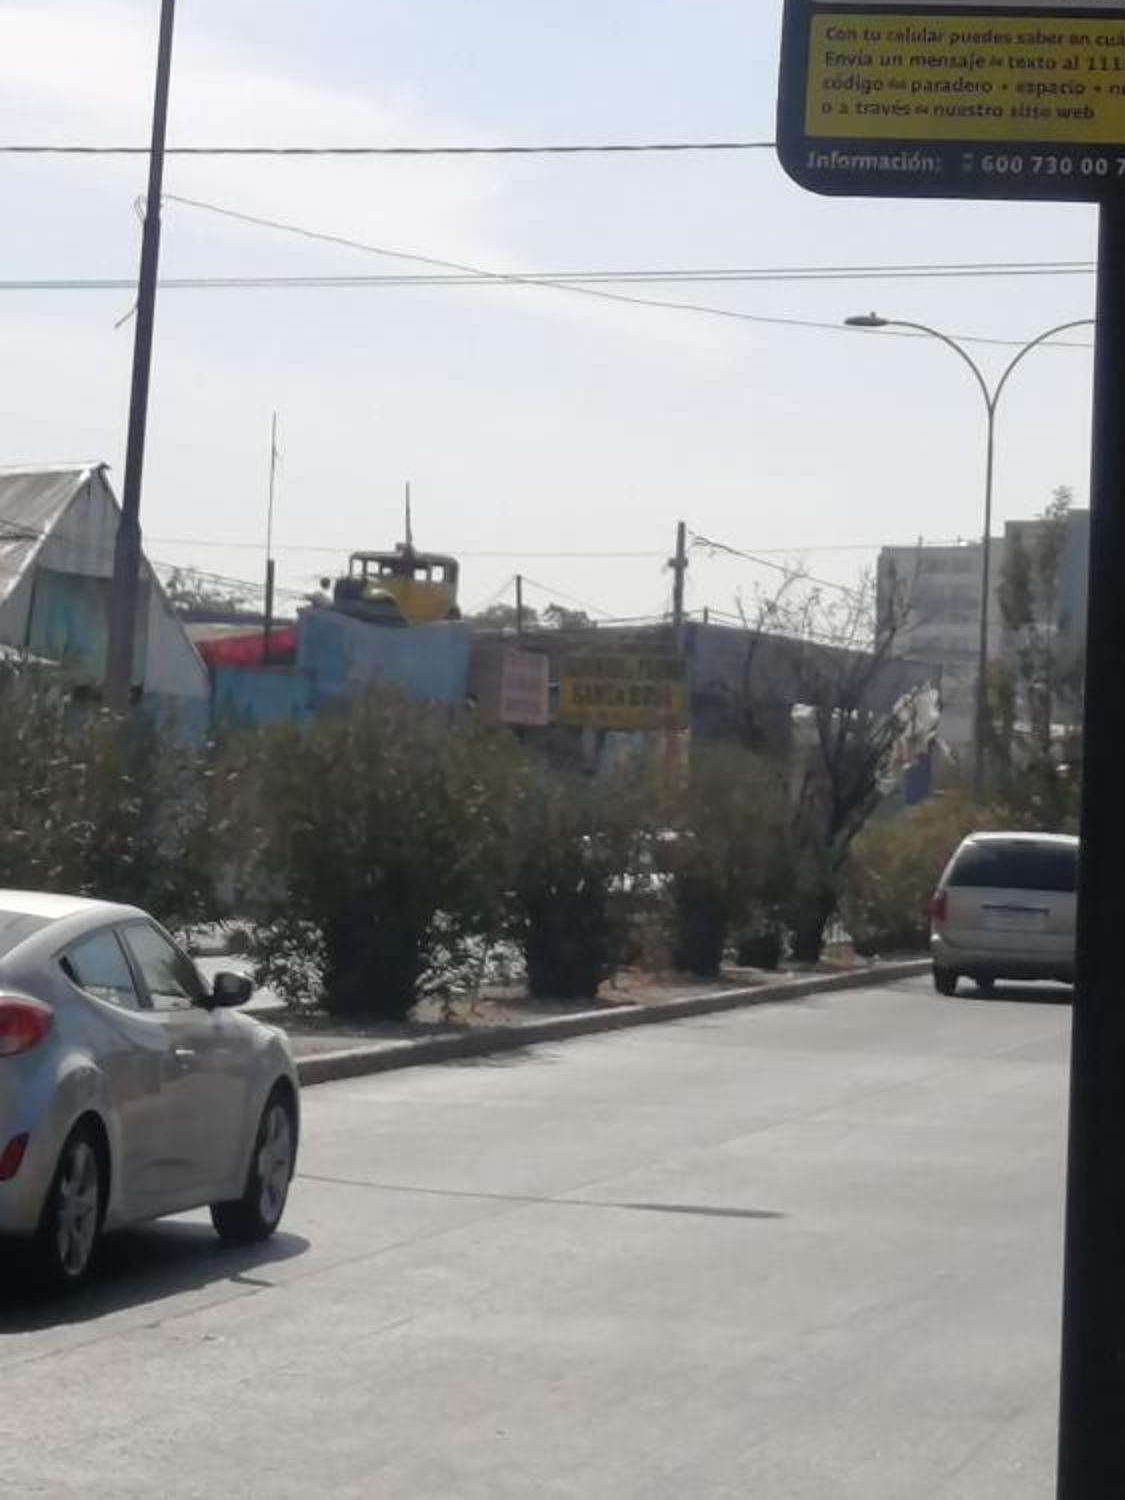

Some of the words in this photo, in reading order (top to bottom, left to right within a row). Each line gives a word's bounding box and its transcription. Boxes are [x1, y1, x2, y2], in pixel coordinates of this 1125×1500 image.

[826, 27, 857, 42] Con
[863, 28, 880, 42] tu
[885, 28, 944, 44] celular
[949, 31, 1010, 48] puedes
[1015, 31, 1064, 46] saber
[1070, 34, 1089, 46] en
[825, 51, 874, 70] Envía
[880, 55, 904, 68] un
[910, 53, 985, 72] mensaje
[1009, 56, 1055, 71] texto
[1061, 56, 1080, 71] al
[821, 77, 882, 95] código
[911, 79, 992, 96] paradero
[1016, 81, 1086, 98] espacio
[821, 103, 832, 114] o
[855, 101, 910, 117] través
[933, 103, 1001, 119] nuestro
[1057, 105, 1095, 120] web
[806, 150, 942, 174] Información:
[981, 155, 1024, 175] 600
[1031, 156, 1073, 176] 730
[1081, 157, 1108, 177] 00
